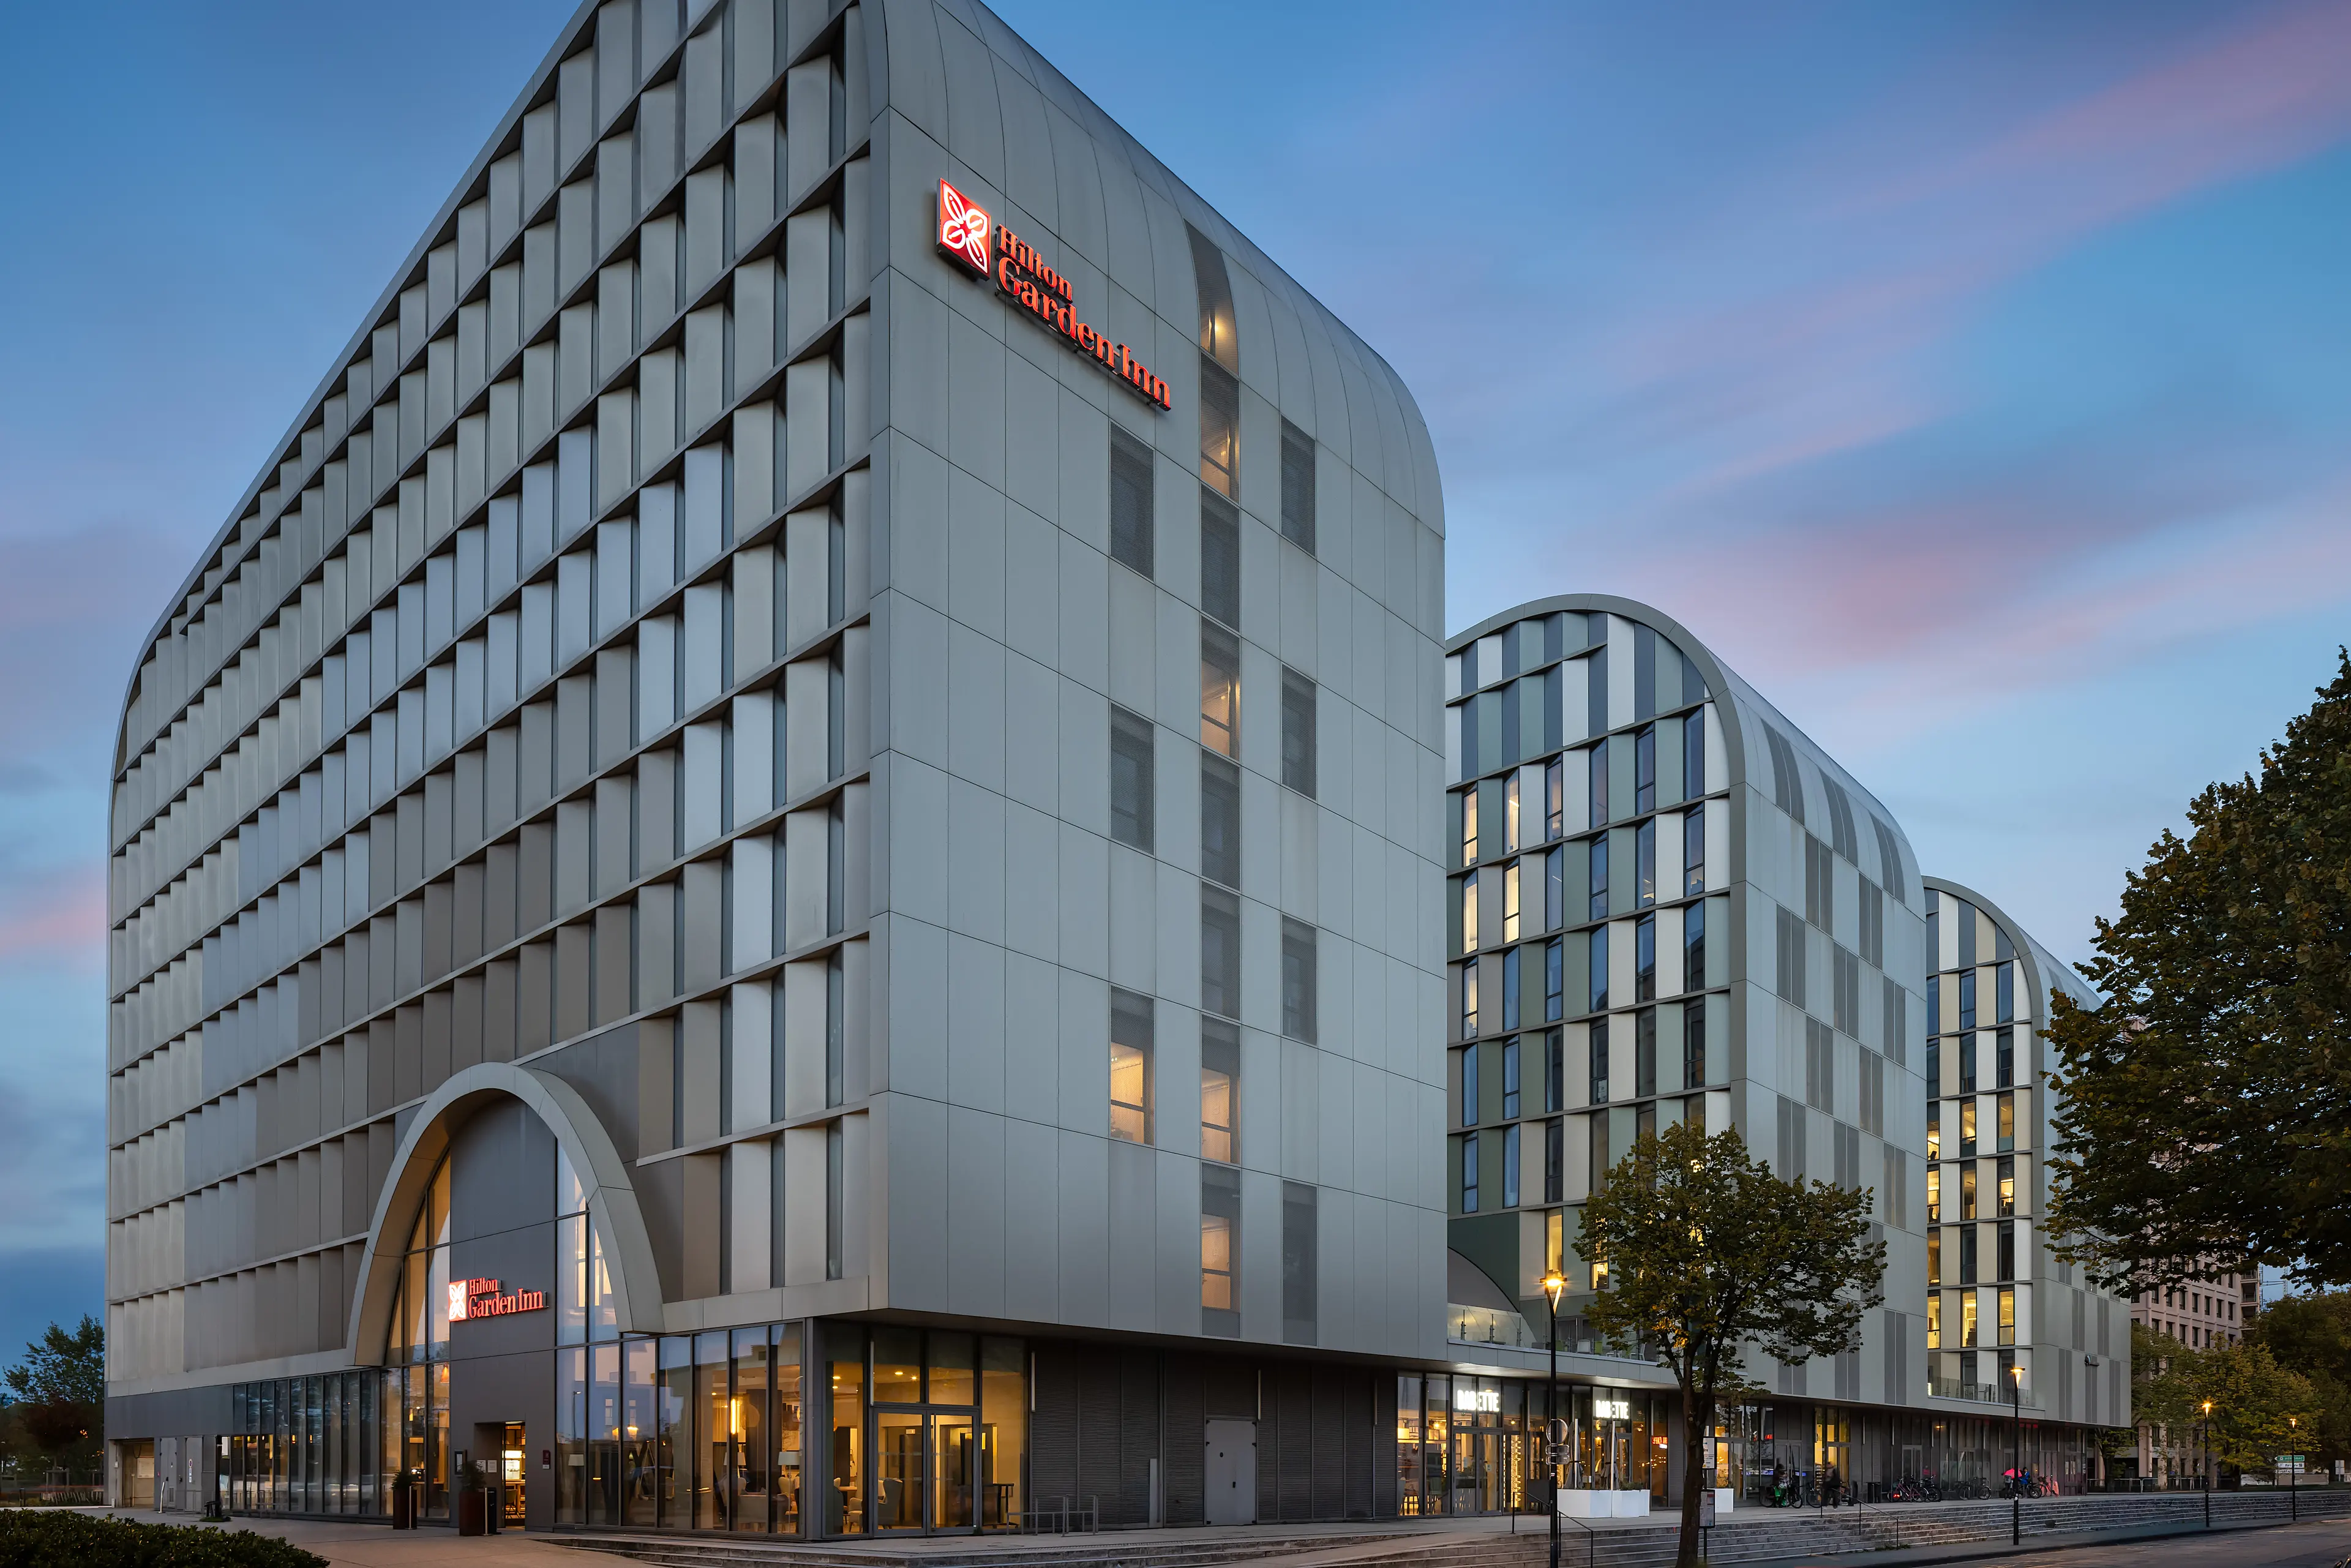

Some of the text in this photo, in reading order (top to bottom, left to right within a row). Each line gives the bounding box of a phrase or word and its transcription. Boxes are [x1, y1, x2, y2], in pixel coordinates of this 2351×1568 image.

[996, 224, 1073, 303] Hilton
[997, 257, 1171, 411] Garden Inn
[468, 1288, 544, 1318] Garden Inn
[469, 1277, 498, 1295] Hilton
